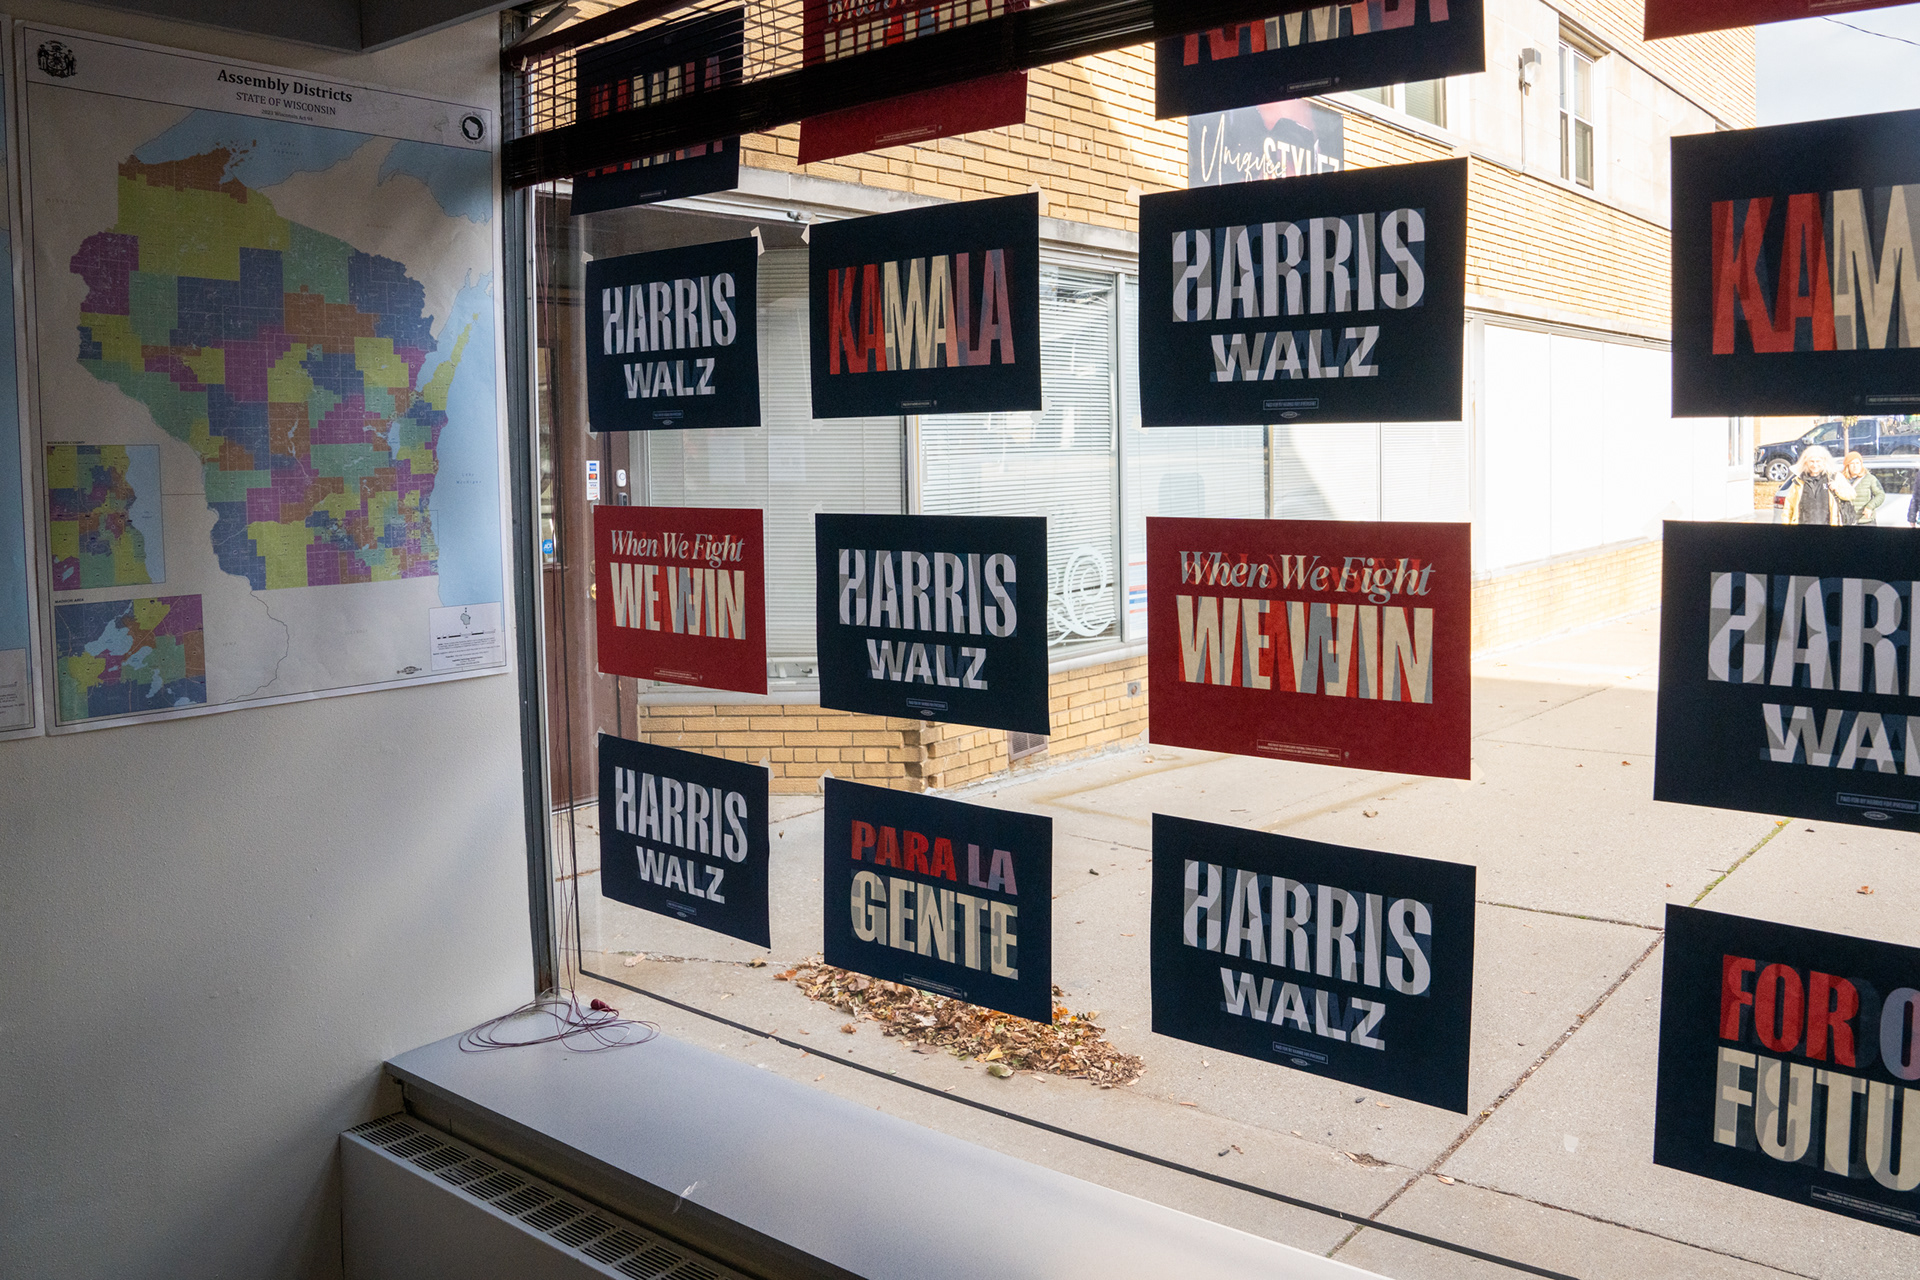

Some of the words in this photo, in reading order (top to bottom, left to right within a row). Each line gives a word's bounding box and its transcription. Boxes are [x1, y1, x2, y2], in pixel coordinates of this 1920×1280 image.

[217, 69, 290, 94] Assembly
[293, 82, 353, 103] Districts
[236, 92, 266, 105] STATE
[268, 97, 282, 106] OF
[283, 99, 336, 115] WISCONSIN
[1172, 208, 1426, 322] HARRIS
[602, 273, 737, 355] HARRIS
[828, 249, 1015, 374] KAMALA
[624, 358, 715, 399] WALZ
[1211, 326, 1379, 382] WALZ
[611, 530, 658, 557] When
[663, 532, 689, 560] We
[691, 534, 745, 568] Fight
[1179, 551, 1271, 588] When
[1280, 554, 1329, 591] We
[1335, 556, 1436, 604] Fight
[610, 562, 660, 631] WE
[666, 566, 746, 640] WIN
[838, 549, 1017, 637] HARRIS
[1708, 571, 1920, 698] HAR
[866, 639, 988, 690] WALZ
[1176, 594, 1271, 690] WE
[1286, 601, 1434, 704] WIN
[615, 766, 749, 863] HARRIS
[636, 846, 725, 904] WALZ
[851, 820, 957, 882] PARA
[968, 843, 1018, 895] LA
[851, 870, 1019, 980] GENTE
[1183, 859, 1432, 995] HARRIS
[1220, 966, 1385, 1051] WALZ
[1719, 954, 1859, 1068] FOR
[1713, 1046, 1920, 1192] FUTU
